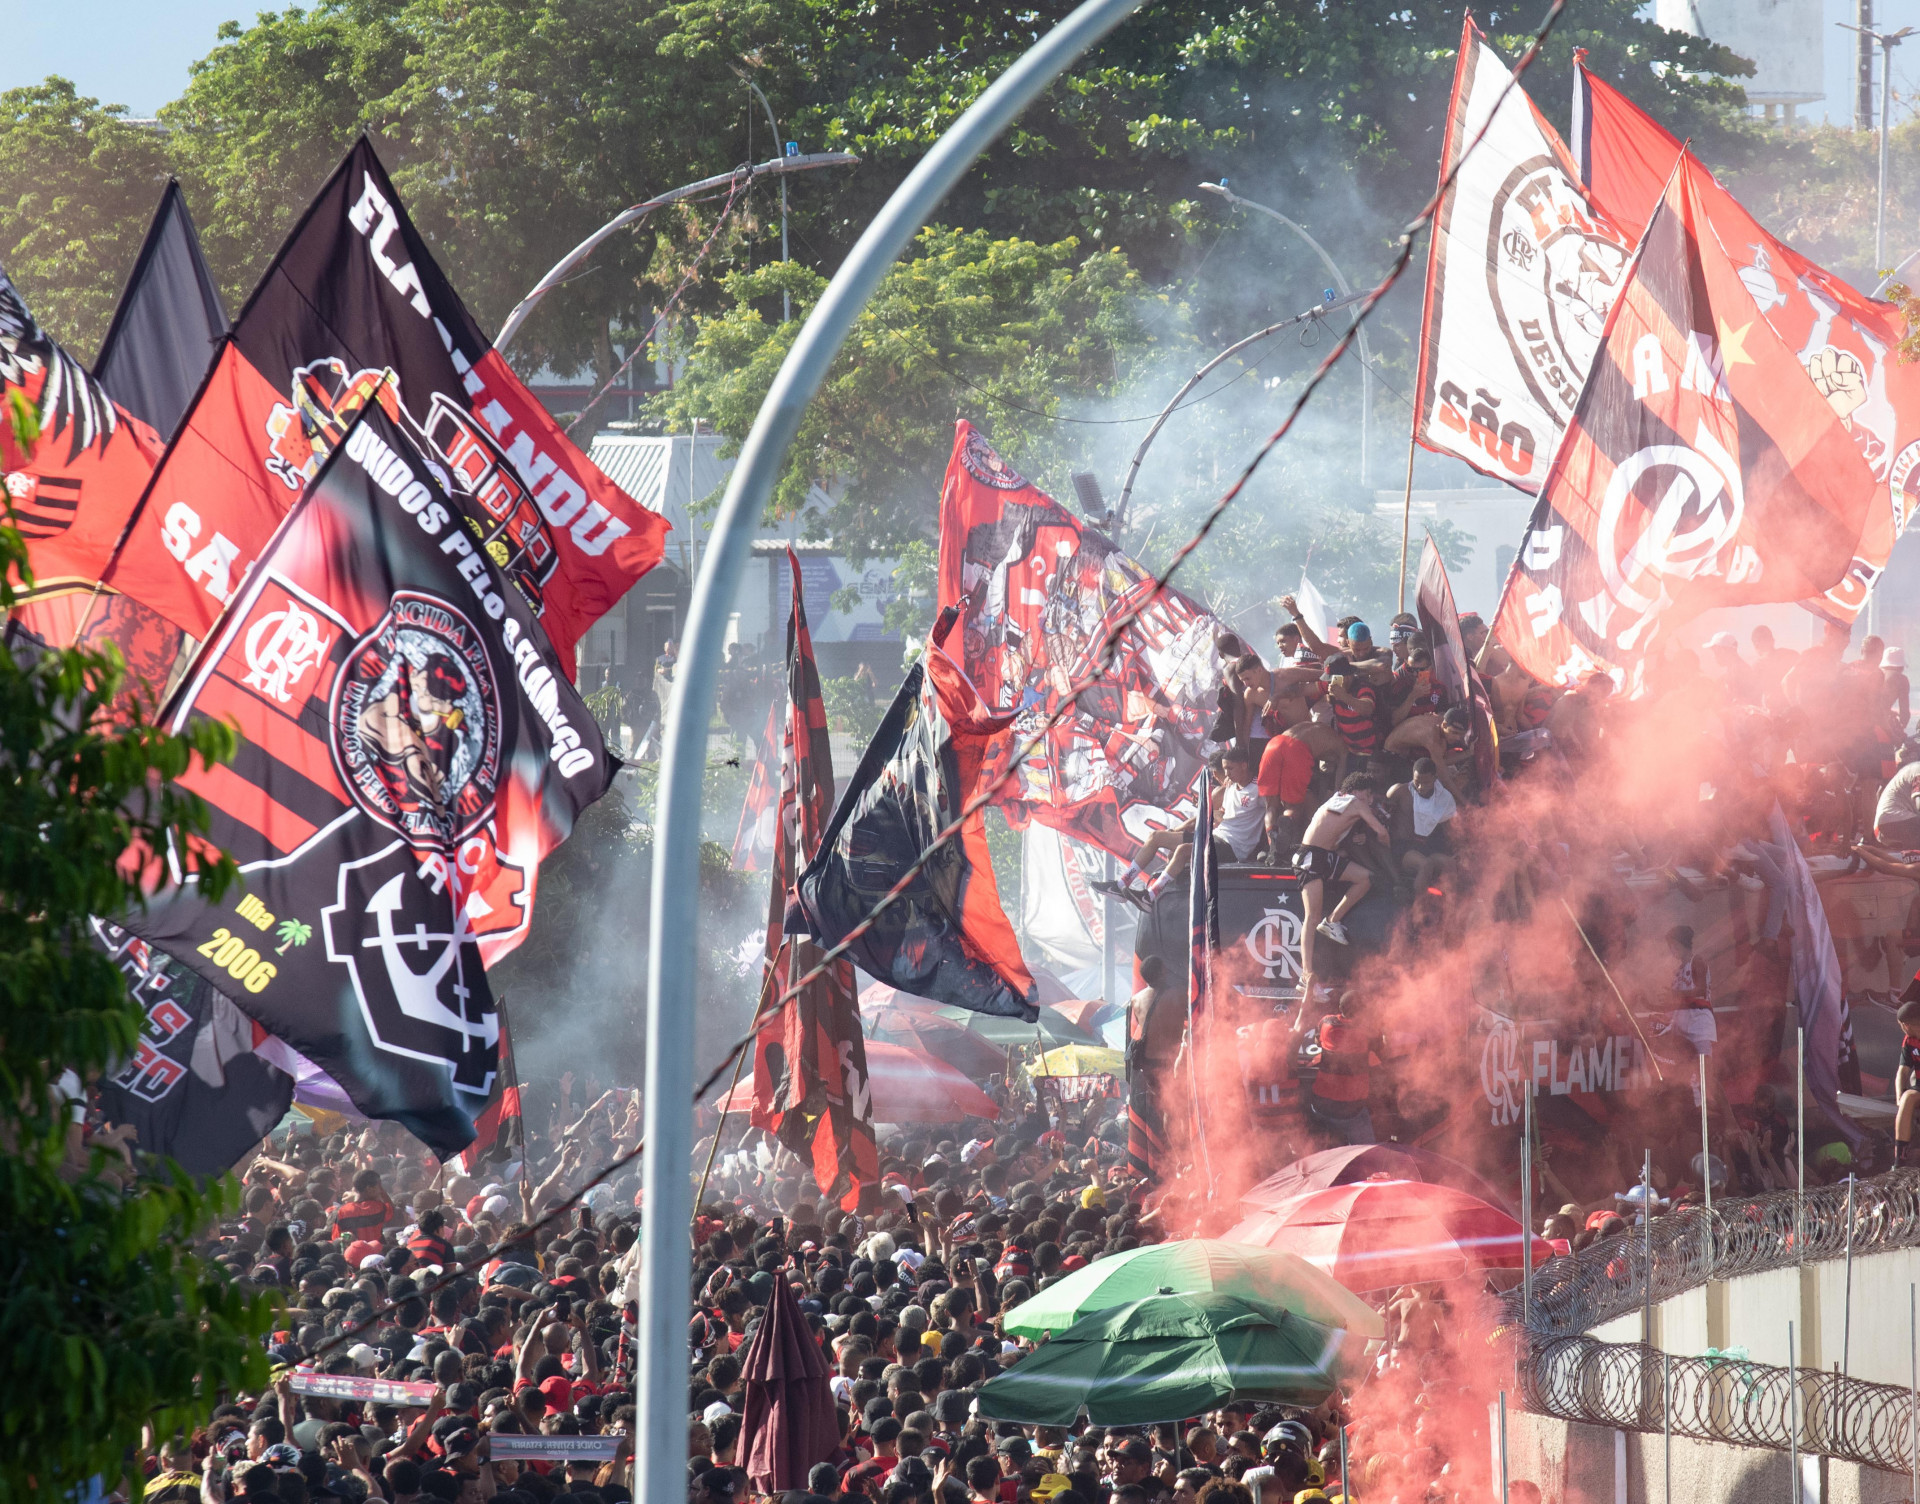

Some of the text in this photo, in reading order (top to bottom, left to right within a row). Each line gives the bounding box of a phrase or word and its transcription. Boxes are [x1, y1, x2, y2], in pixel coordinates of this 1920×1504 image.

[1439, 380, 1536, 476] SÃO
[160, 501, 257, 609] SA
[345, 417, 450, 535] UNIDOS
[439, 529, 505, 620] PELO
[234, 892, 276, 932] Ilha
[195, 927, 278, 994] 2006
